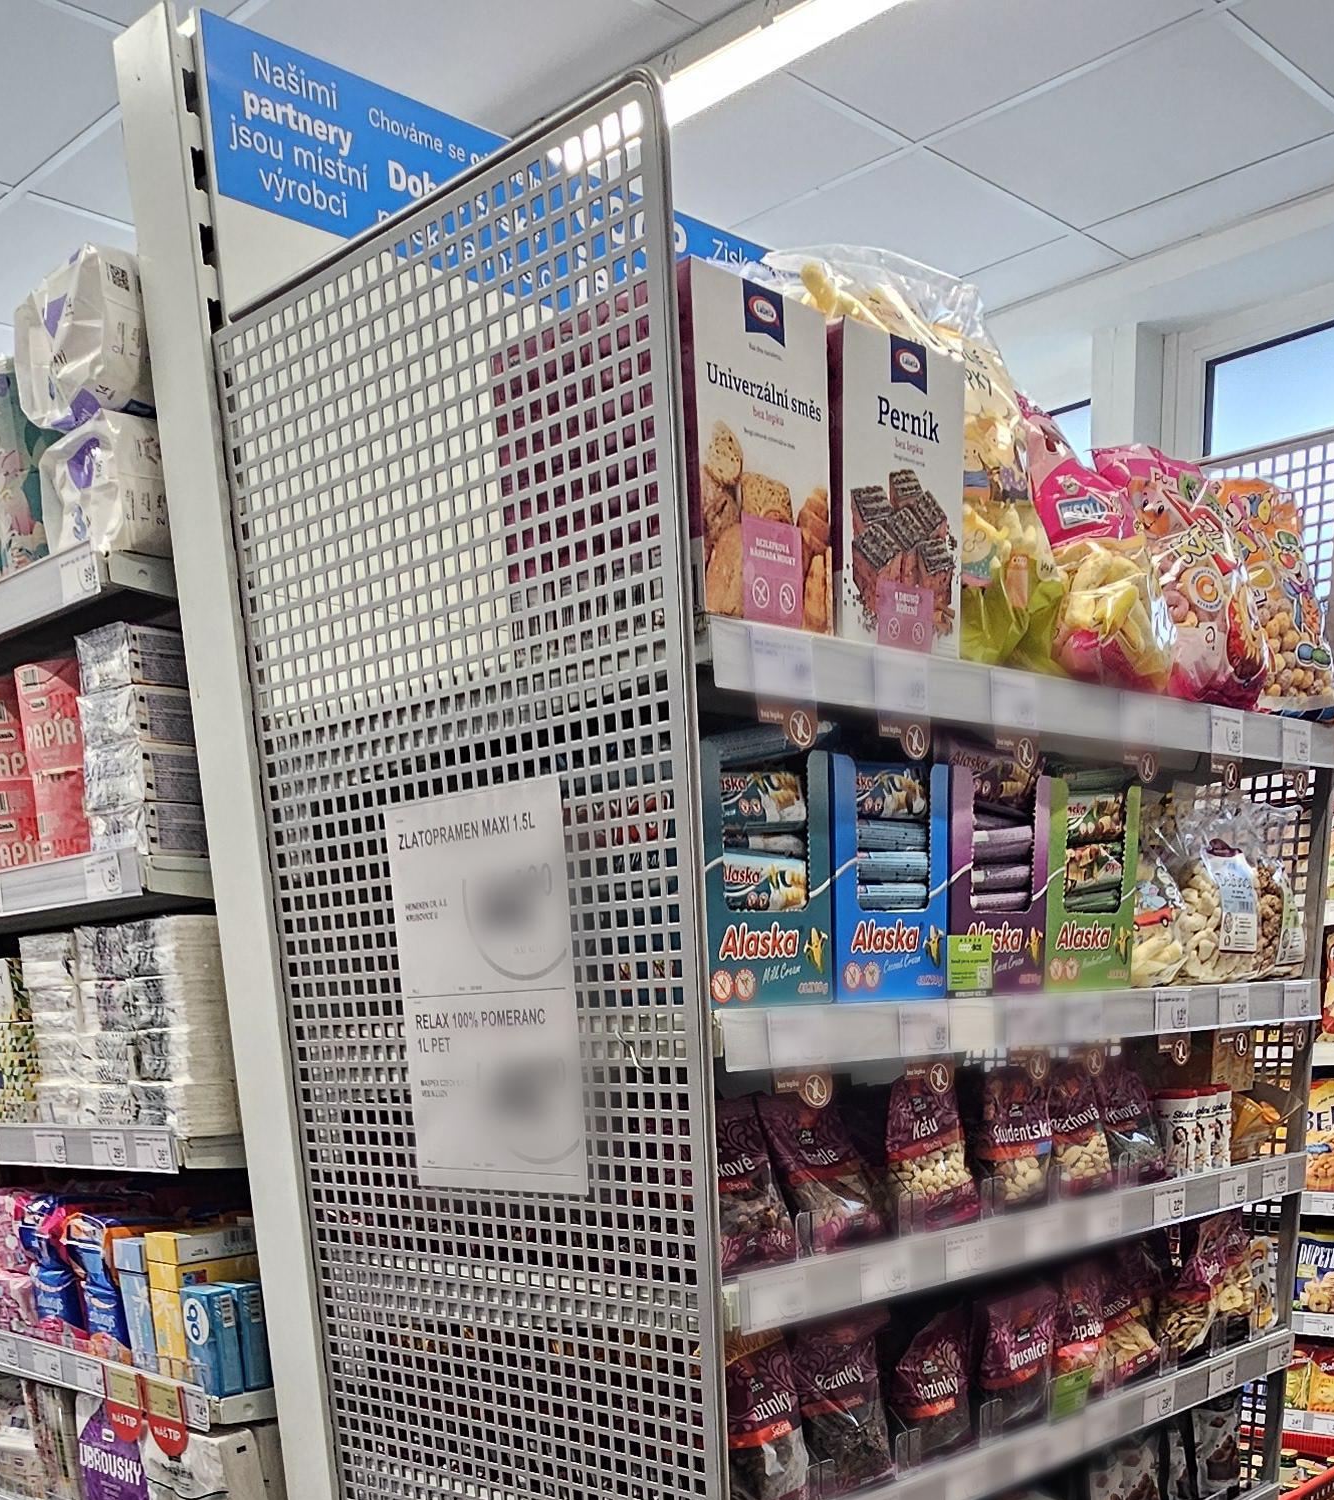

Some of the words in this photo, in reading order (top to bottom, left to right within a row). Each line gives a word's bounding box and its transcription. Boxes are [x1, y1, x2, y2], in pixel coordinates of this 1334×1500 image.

[252, 51, 338, 111] Našimi
[243, 90, 352, 155] partnery
[369, 107, 443, 153] Chováme
[448, 143, 465, 161] se
[230, 117, 283, 160] jsou
[294, 144, 368, 192] místní
[259, 167, 348, 219] výrobci
[706, 361, 789, 411] Univerzální
[791, 399, 822, 423] směs
[877, 395, 940, 444] Perník
[27, 713, 78, 749] PAPÍR
[399, 820, 479, 851] ZLATOPRAMEN
[482, 815, 511, 841] MAXI
[513, 812, 535, 835] 1.5L
[719, 921, 800, 961] Alaska
[851, 919, 920, 955] Alaska
[1056, 920, 1113, 951] Alaska
[416, 1012, 449, 1031] RELAX
[452, 1010, 478, 1029] 100%
[481, 1008, 546, 1028] POMERANC
[418, 1037, 429, 1053] 1L
[432, 1036, 451, 1052] PET
[912, 1117, 940, 1141] Kešu
[1009, 1341, 1049, 1371] Brusnice
[815, 1363, 865, 1393] Rozinky
[917, 1375, 960, 1400] Rozinky
[166, 1429, 181, 1441] TIP
[79, 1441, 144, 1487] UBROUSKY
